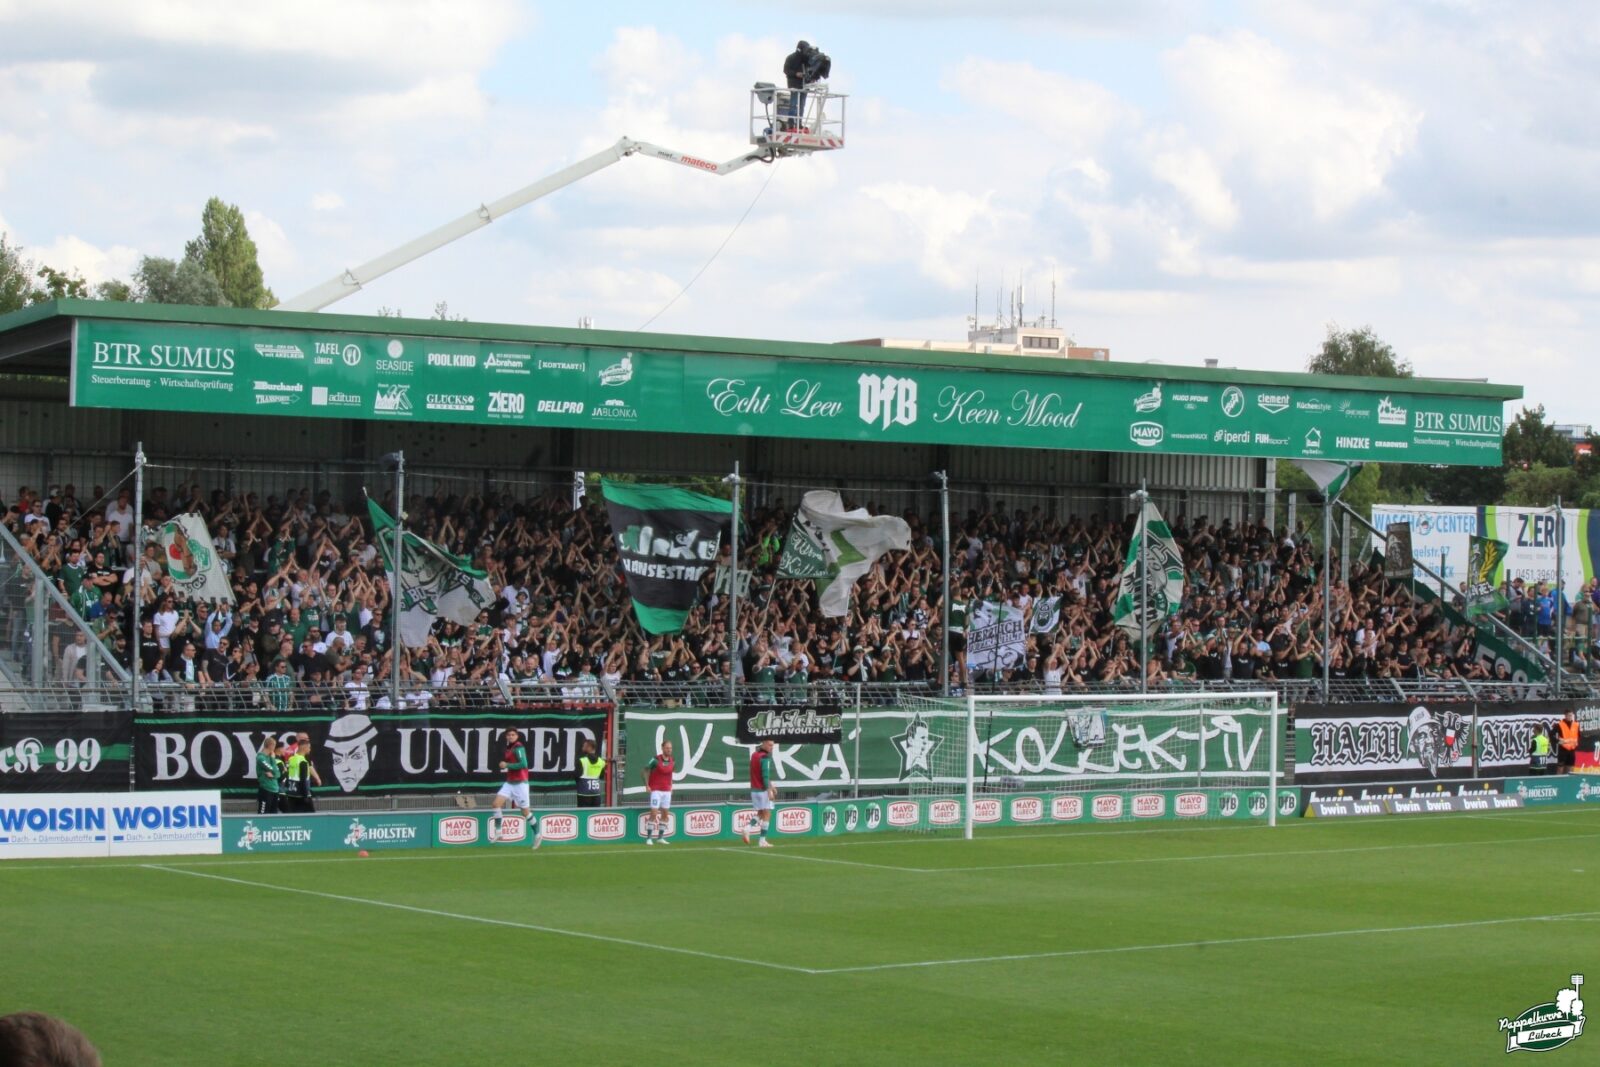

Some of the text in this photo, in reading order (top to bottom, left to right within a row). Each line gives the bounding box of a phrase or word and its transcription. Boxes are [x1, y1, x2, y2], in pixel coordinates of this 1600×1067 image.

[681, 155, 717, 171] mateco
[315, 342, 340, 355] TAFEL
[93, 342, 142, 365] BTR
[150, 345, 235, 370] SUMUS
[376, 360, 414, 371] SEASIDE
[91, 374, 234, 391] Steuerberatung Wirtschaftsprüfung
[328, 392, 361, 403] aditum
[706, 378, 843, 418] Echt Leev
[1258, 393, 1289, 404] clement
[537, 400, 584, 414] DELLPRO
[592, 407, 638, 418] JABLONKA
[933, 386, 1082, 429] Keen Mood
[1415, 411, 1445, 430] BTR
[1448, 413, 1501, 432] SUMUS
[1133, 427, 1160, 437] MAYO
[1223, 430, 1250, 445] iperdi
[1336, 437, 1370, 449] HINZKE
[1437, 515, 1476, 533] CENTER
[969, 621, 1022, 643] HERZICH
[55, 737, 101, 773] 99
[1528, 788, 1557, 797] HOLSTEN
[1353, 801, 1380, 813] bwin
[1394, 800, 1420, 812] bwin
[1426, 799, 1451, 811] bwin
[1463, 797, 1487, 809] bwin
[1493, 796, 1518, 808] bwin
[1320, 803, 1347, 816] bwin
[0, 805, 217, 832] WOISIN WOISIN
[594, 818, 620, 826] MAYO
[691, 814, 715, 822] MAYO
[782, 812, 806, 820] MAYO
[502, 820, 520, 828] AYO
[546, 819, 572, 827] MAYO
[263, 830, 312, 842] HOLSTEN
[368, 827, 416, 839] HOLSTEN
